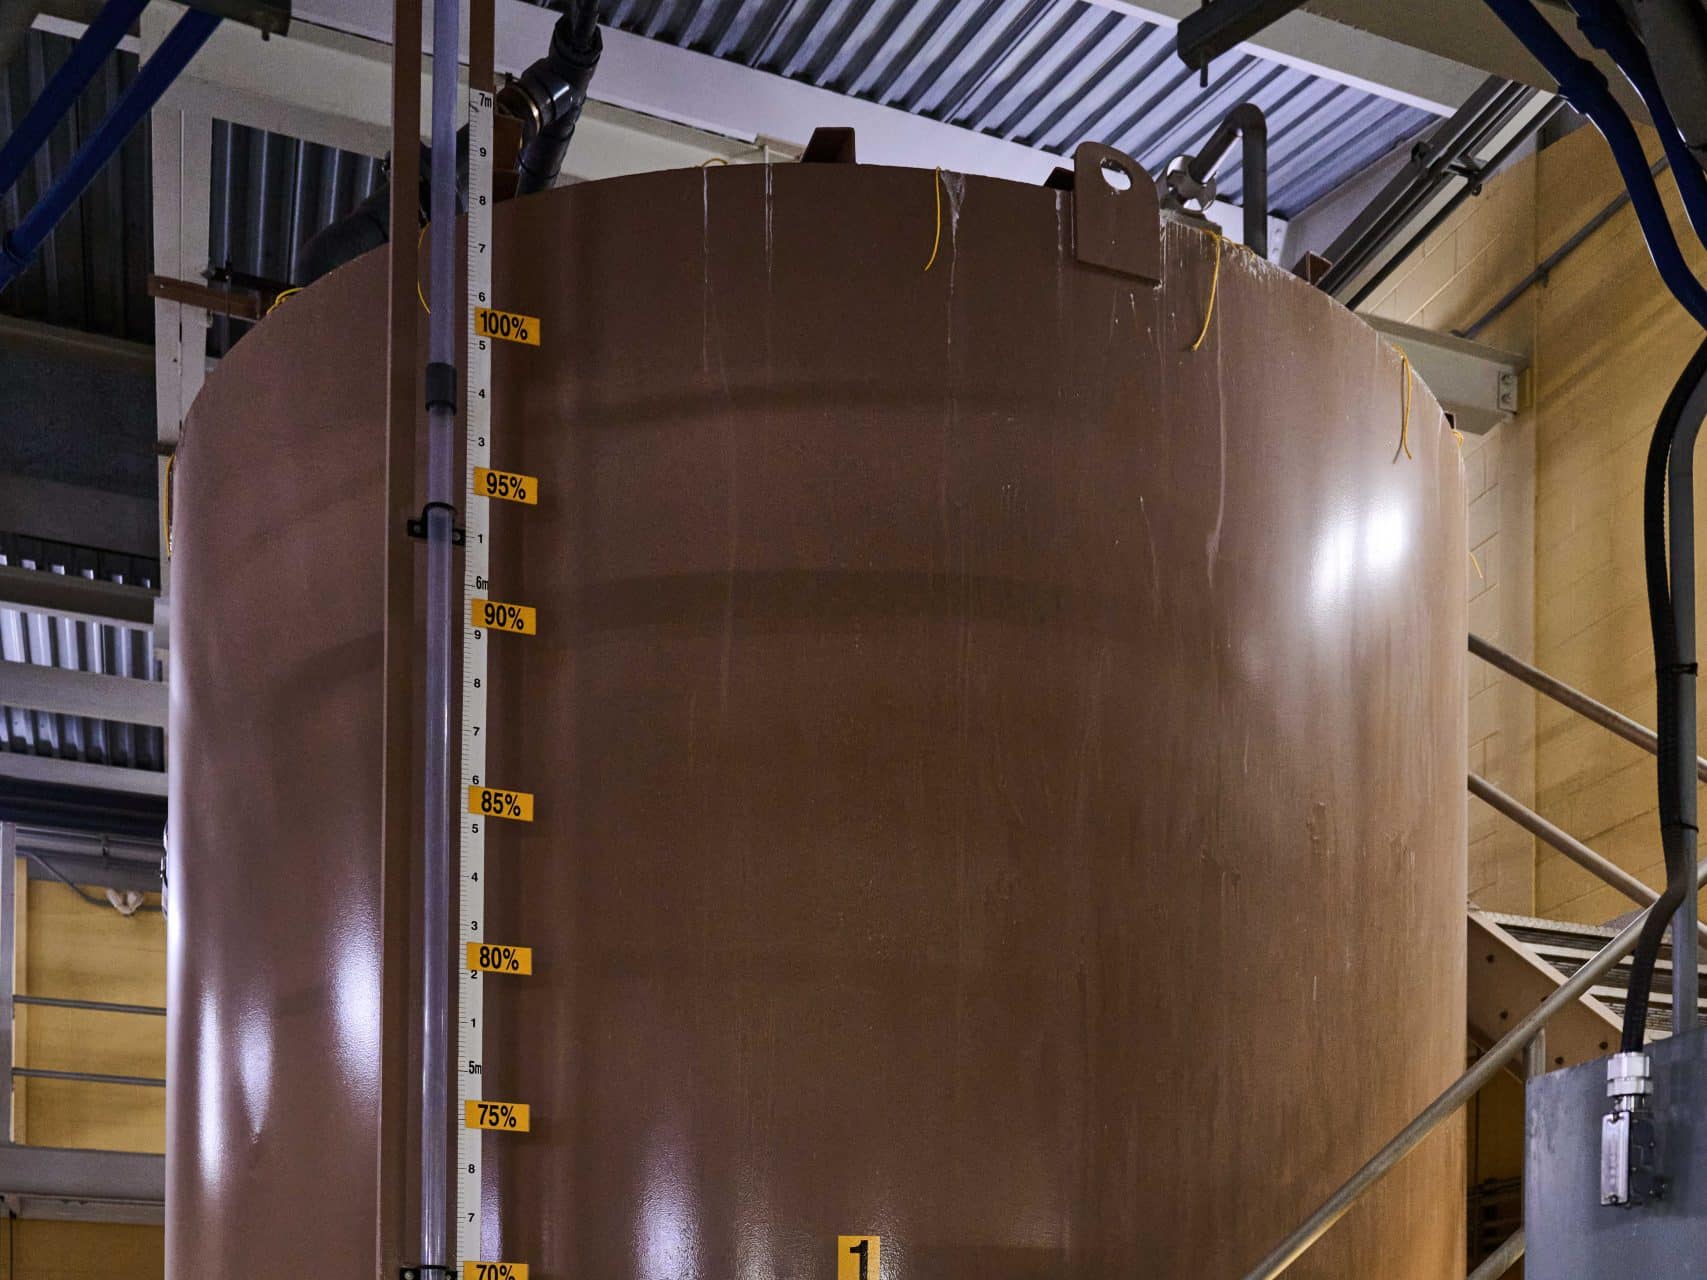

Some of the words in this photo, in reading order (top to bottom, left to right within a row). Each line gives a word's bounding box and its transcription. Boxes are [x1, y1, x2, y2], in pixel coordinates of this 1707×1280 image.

[480, 93, 492, 108] 7m
[480, 147, 486, 157] 9
[479, 196, 486, 206] 8
[478, 243, 486, 253] 7
[478, 292, 486, 302] 6
[480, 311, 528, 340] 100%
[478, 340, 486, 350] 5
[478, 388, 485, 399] 4
[478, 437, 485, 447] 3
[486, 472, 526, 500] 95%
[478, 534, 483, 544] 1
[476, 576, 489, 590] 6m
[484, 603, 524, 630] 90%
[474, 630, 481, 640] 9
[473, 678, 480, 688] 8
[473, 727, 480, 736] 7
[472, 775, 479, 785] 6
[481, 791, 521, 816] 85%
[472, 824, 479, 834] 5
[471, 872, 478, 882] 4
[471, 921, 478, 931] 3
[480, 946, 519, 970] 80%
[471, 970, 478, 979] 2
[471, 1018, 476, 1028] 1
[468, 1060, 482, 1074] 5m
[478, 1103, 516, 1128] 75%
[468, 1164, 475, 1174] 8
[468, 1213, 475, 1222] 7
